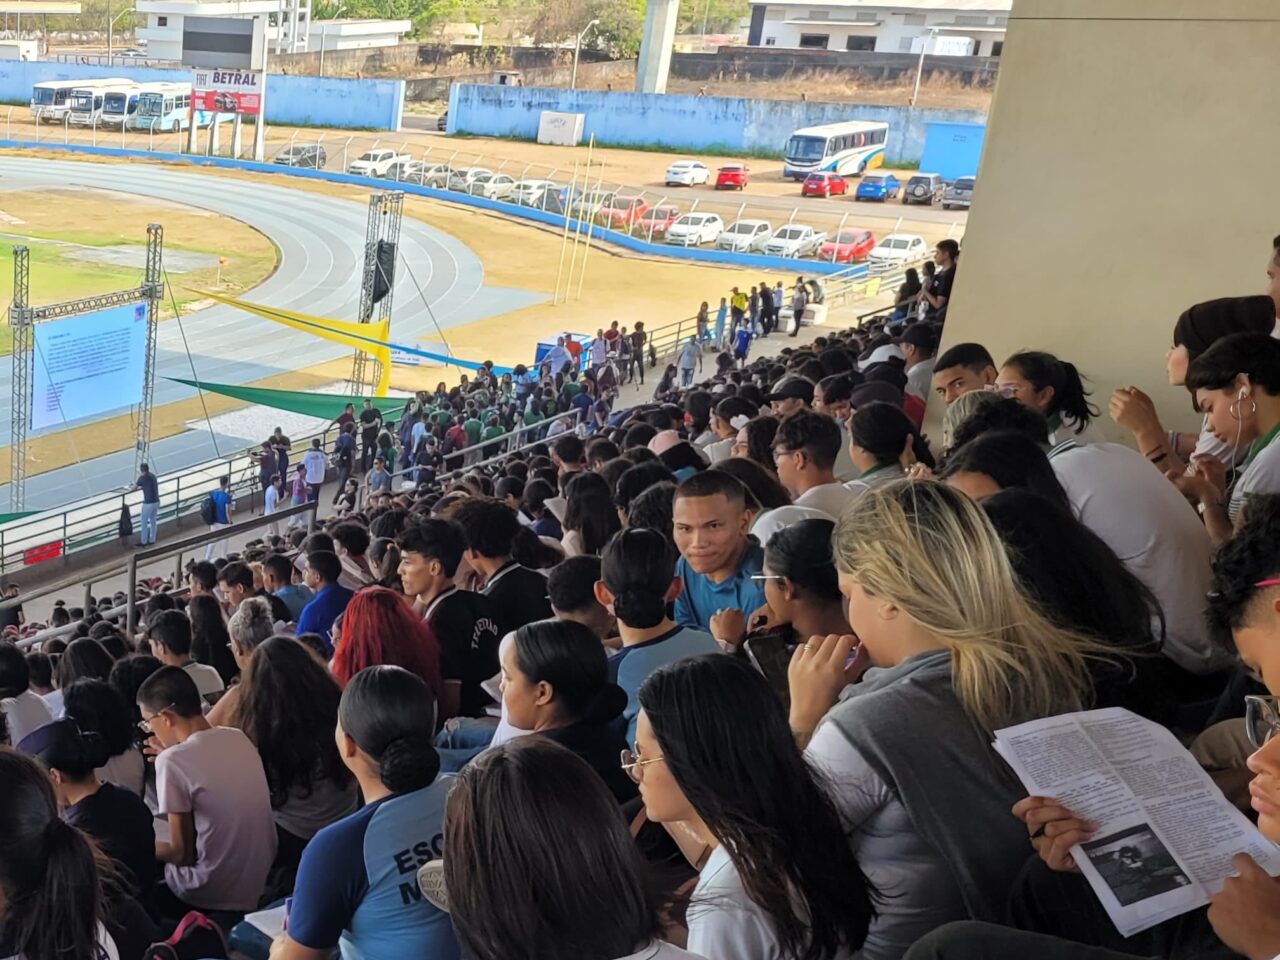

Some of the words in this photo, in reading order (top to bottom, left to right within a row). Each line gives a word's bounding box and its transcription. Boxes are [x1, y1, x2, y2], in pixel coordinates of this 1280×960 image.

[196, 73, 207, 85] FIAT
[213, 72, 256, 85] BETRAL
[393, 833, 443, 875] ESC
